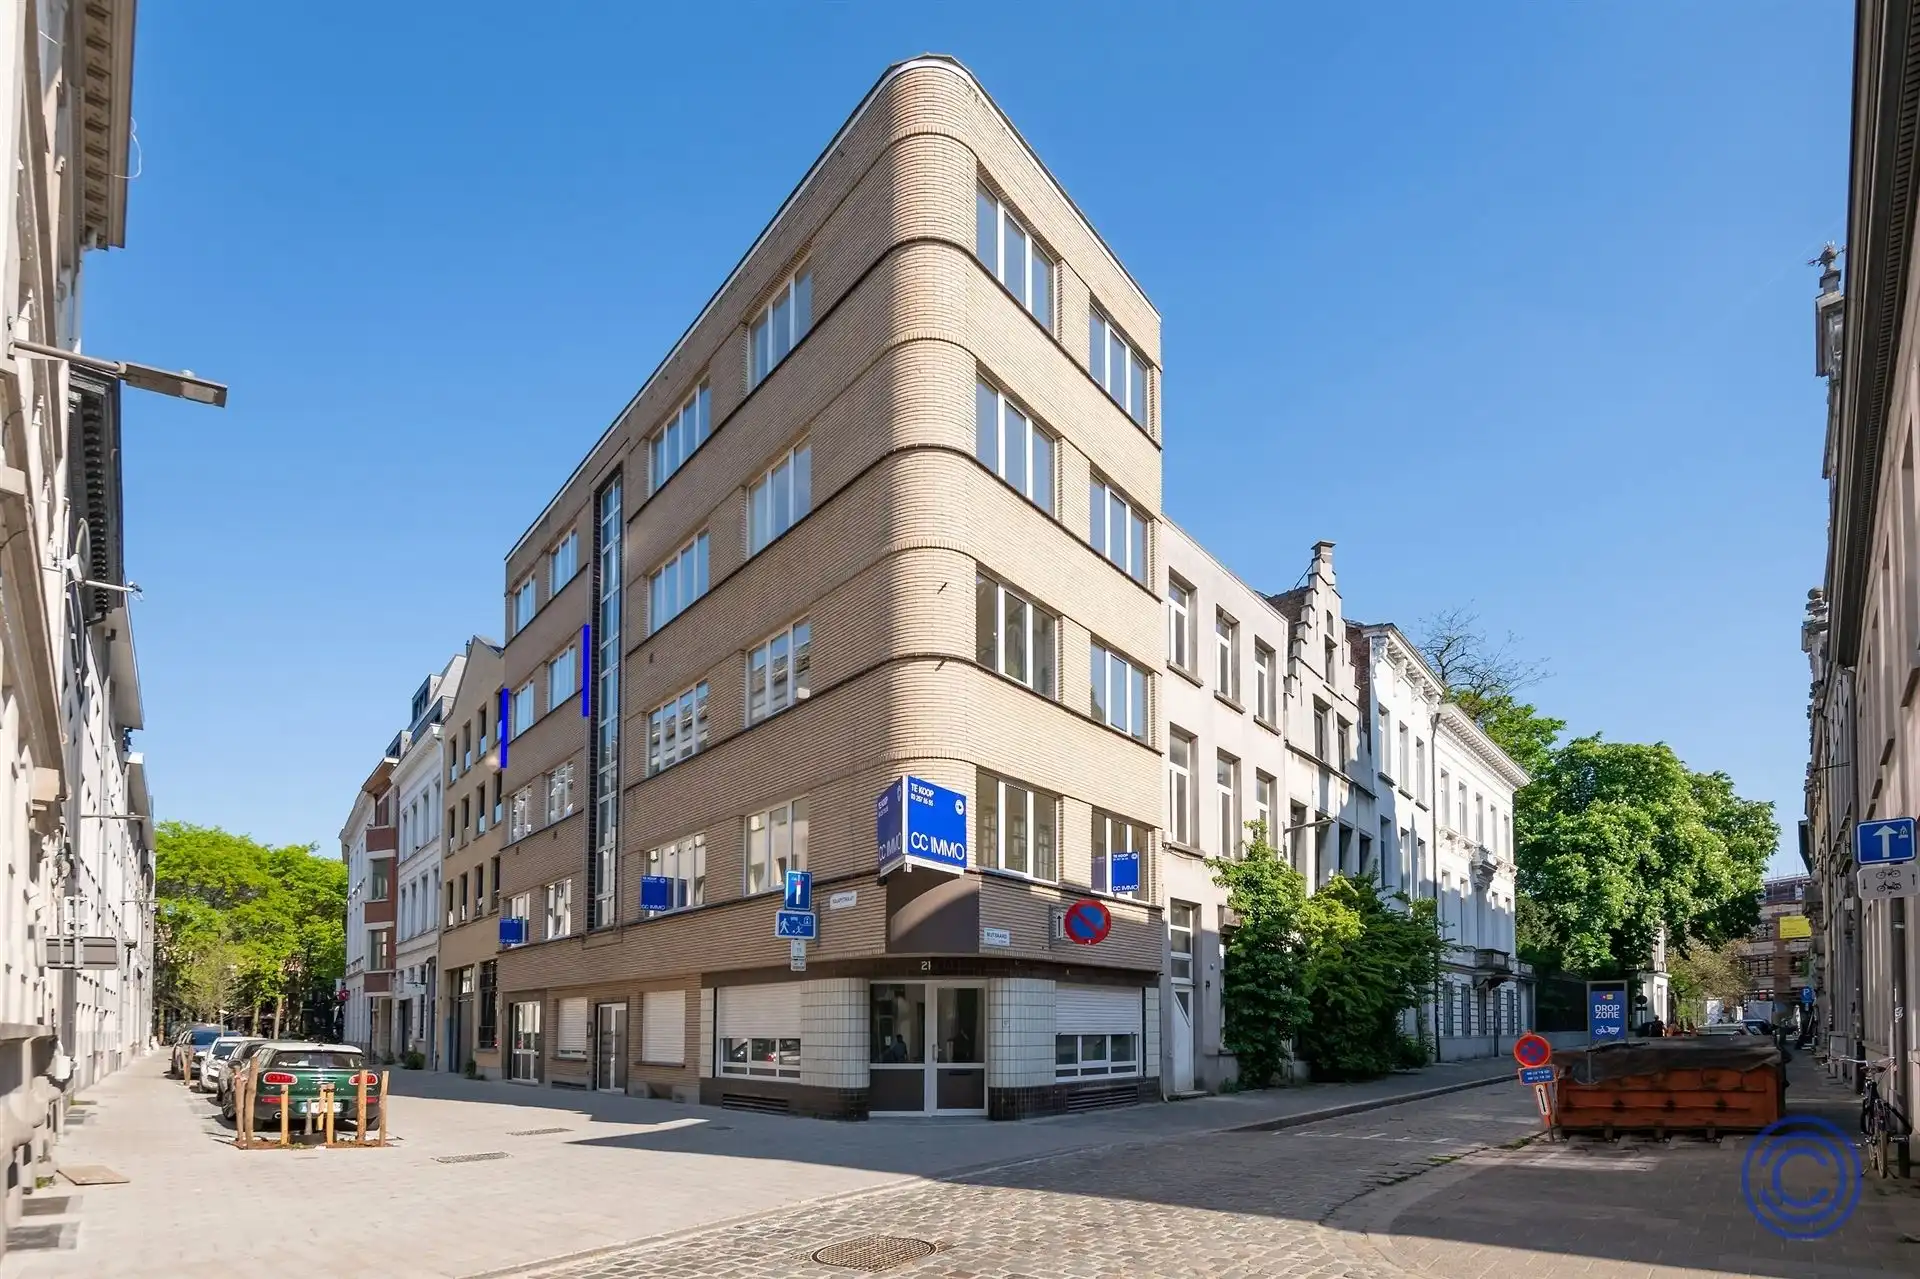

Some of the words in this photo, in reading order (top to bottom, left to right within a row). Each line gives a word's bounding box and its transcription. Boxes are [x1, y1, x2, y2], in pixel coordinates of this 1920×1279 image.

[918, 785, 934, 798] KOOP
[911, 831, 928, 851] CC
[930, 836, 965, 861] IMMO
[921, 960, 931, 971] 21
[1594, 1004, 1620, 1012] DROP
[1595, 1011, 1620, 1019] ZONE
